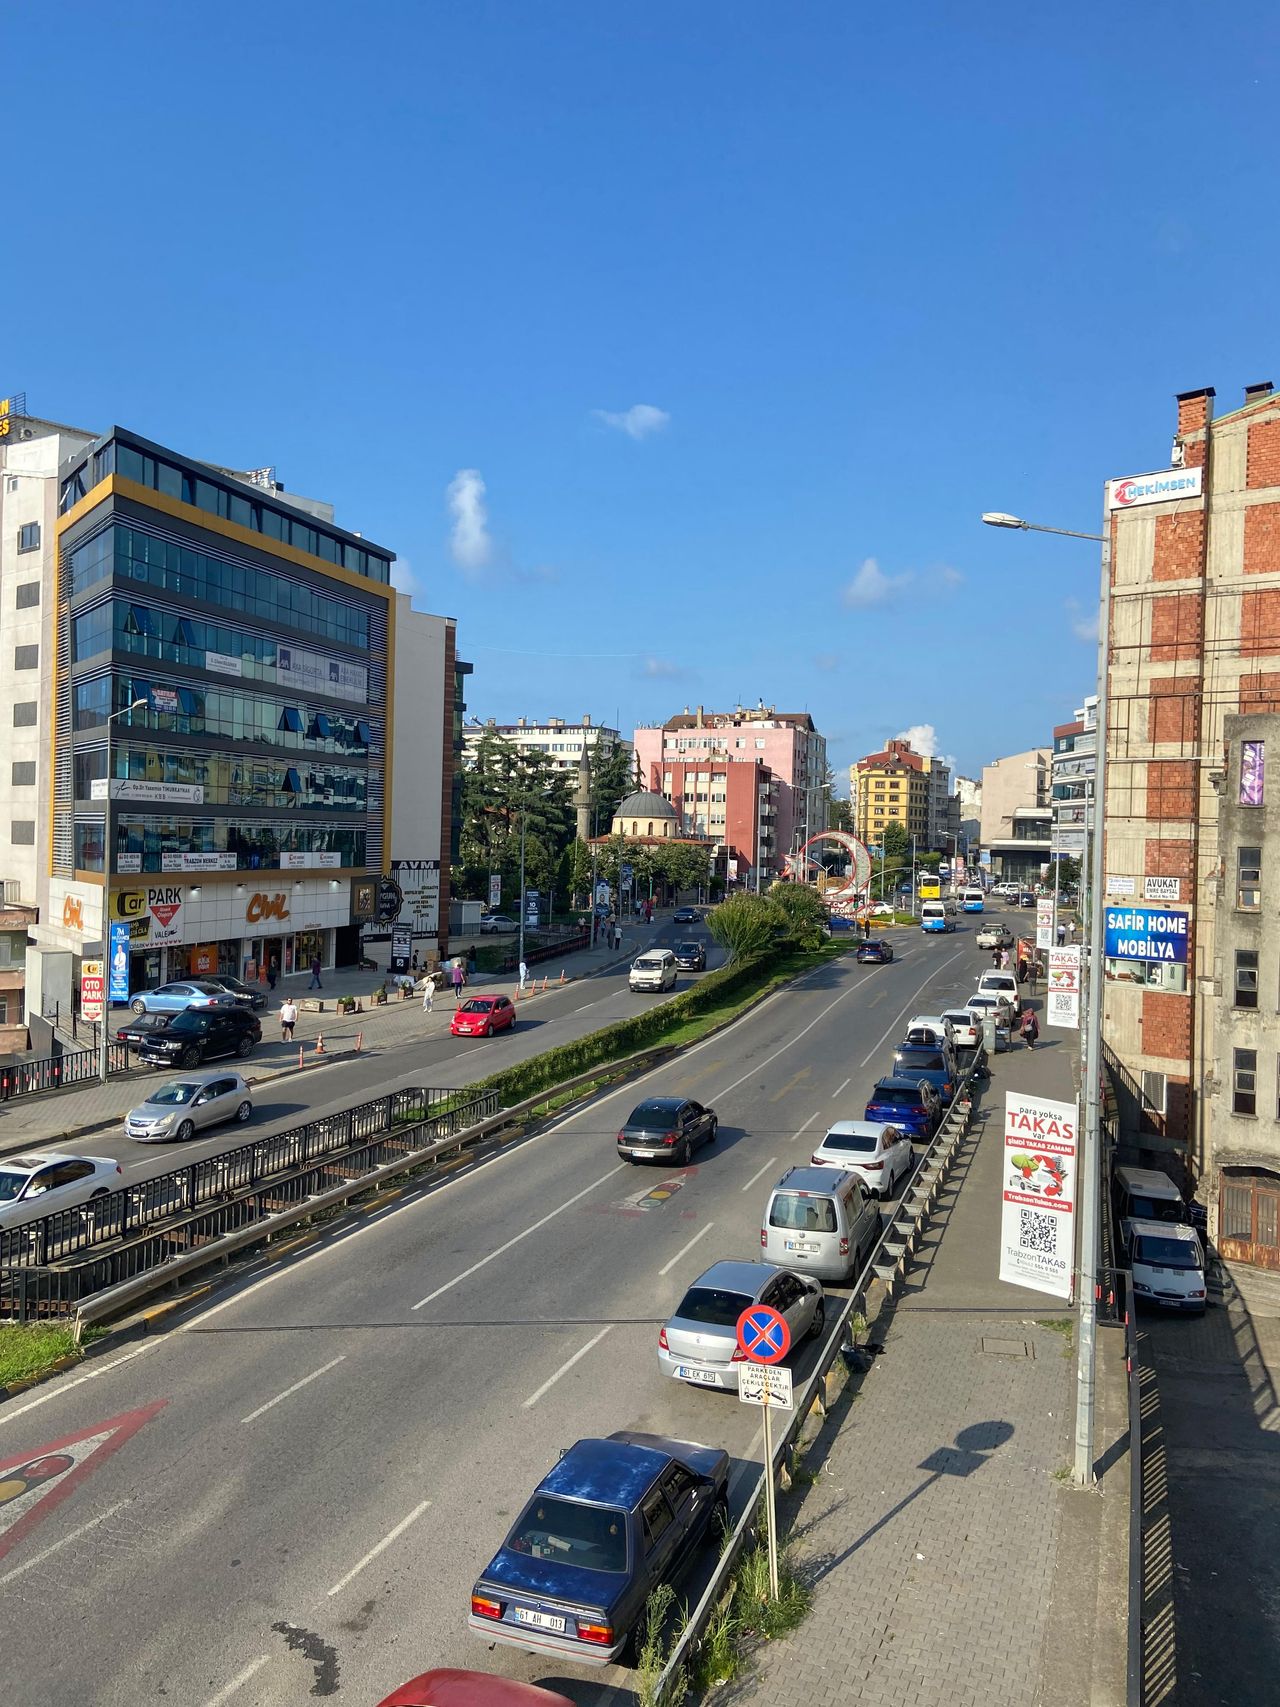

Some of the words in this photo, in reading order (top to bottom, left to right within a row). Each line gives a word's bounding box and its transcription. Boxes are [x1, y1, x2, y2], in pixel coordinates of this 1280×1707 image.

[1129, 477, 1195, 498] HEKİMSEN
[399, 861, 434, 869] AVM
[1147, 879, 1178, 889] AVUKAT
[117, 892, 144, 917] Car
[148, 888, 182, 905] PARK
[1108, 909, 1144, 931] SAFİR
[1148, 915, 1186, 934] HOME
[1118, 936, 1175, 959] MOBİLYA
[1051, 954, 1079, 964] TAKAS
[85, 980, 100, 990] OTO
[83, 990, 102, 1000] PARK
[1019, 1107, 1037, 1116] para
[1038, 1111, 1062, 1121] yoksa
[1008, 1111, 1073, 1140] TAKAS
[1032, 1132, 1045, 1140] var
[1008, 1138, 1025, 1146] ŞİMDİ
[1026, 1140, 1046, 1149] TAKAS
[1047, 1144, 1072, 1153] ZAMANI
[1007, 1247, 1066, 1269] TrabzonTAKAS
[683, 1368, 690, 1376] 61
[703, 1373, 714, 1381] 615
[747, 1366, 782, 1376] PARKEDEN
[750, 1373, 780, 1381] ARAÇLAR
[742, 1379, 789, 1391] ÇEKİLECEKTİR
[519, 1610, 528, 1619] 61
[532, 1614, 542, 1624] AH
[549, 1617, 563, 1629] 013
